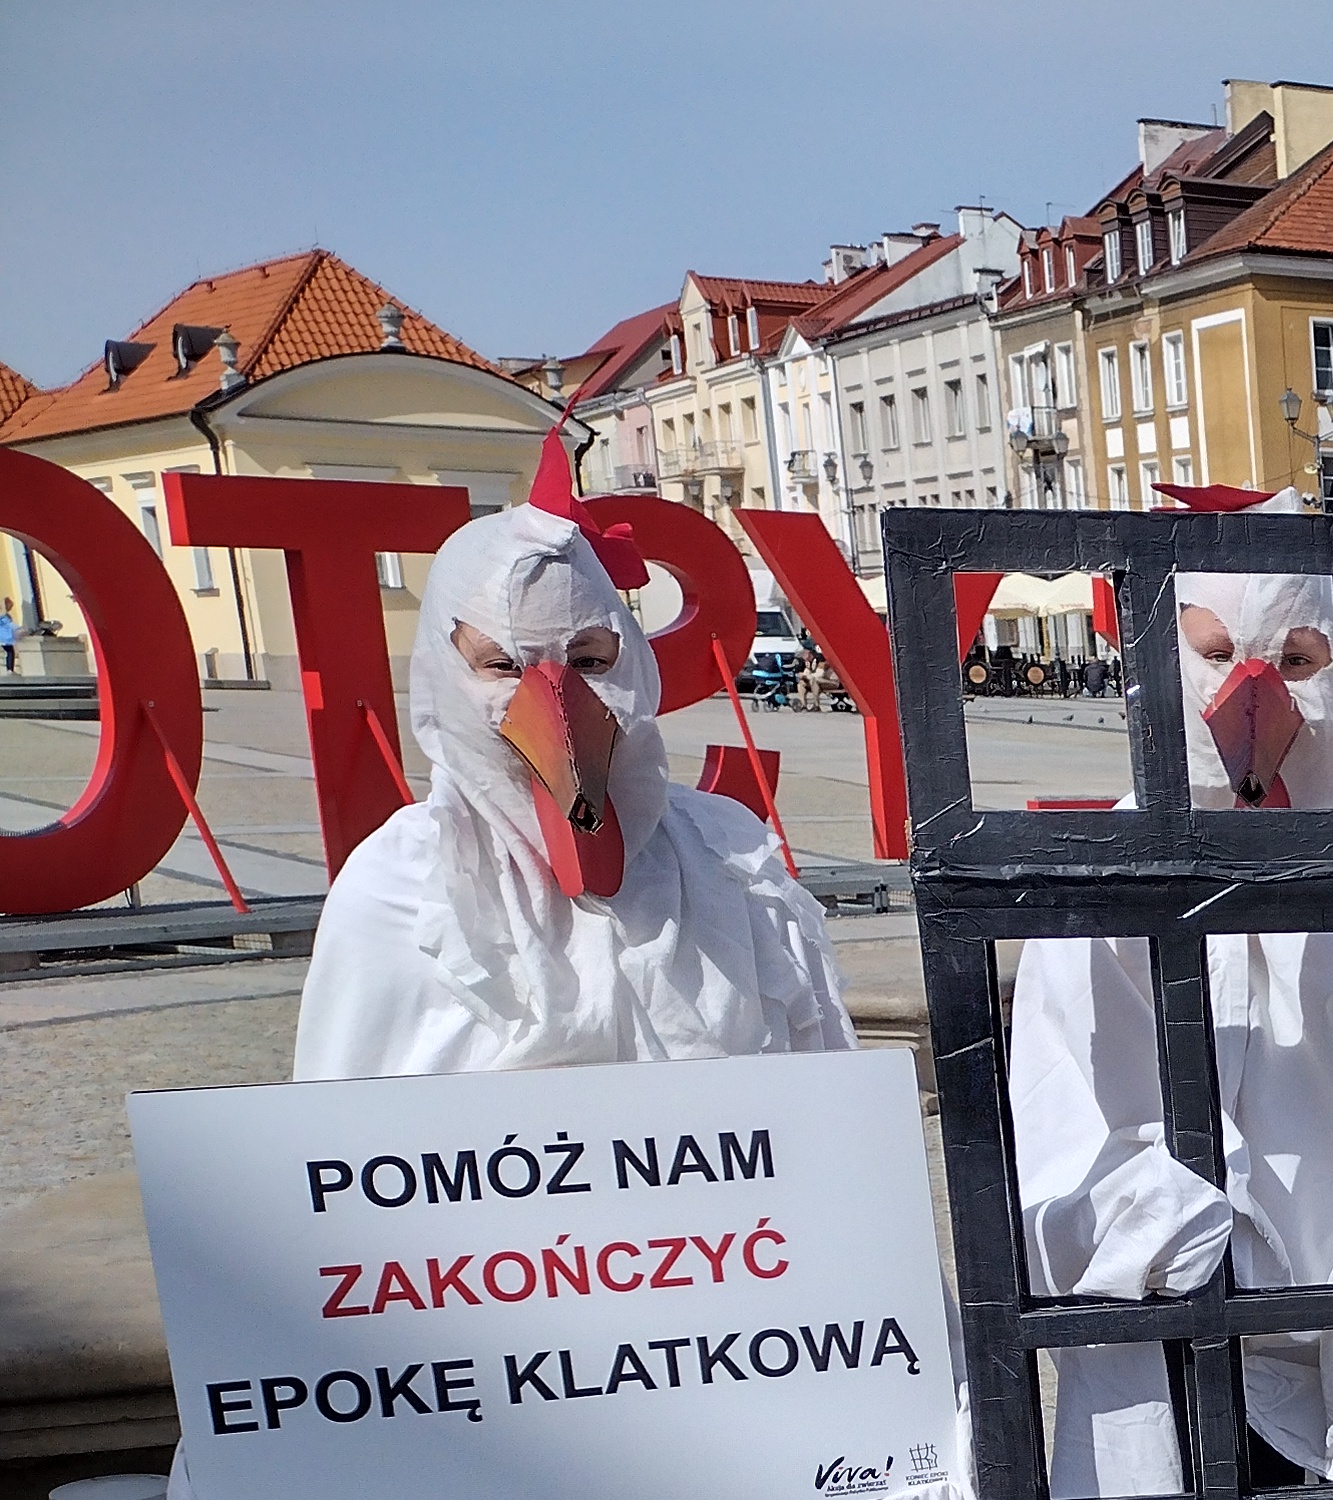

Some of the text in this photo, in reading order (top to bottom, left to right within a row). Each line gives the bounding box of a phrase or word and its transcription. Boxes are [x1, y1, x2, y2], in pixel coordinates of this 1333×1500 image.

[307, 1128, 776, 1213] POMÓŻ NAM
[320, 1217, 789, 1319] ZAKOŃCZYĆ
[205, 1317, 922, 1436] EPOKĘ KLATKOWĄ
[814, 1456, 894, 1490] Viva!
